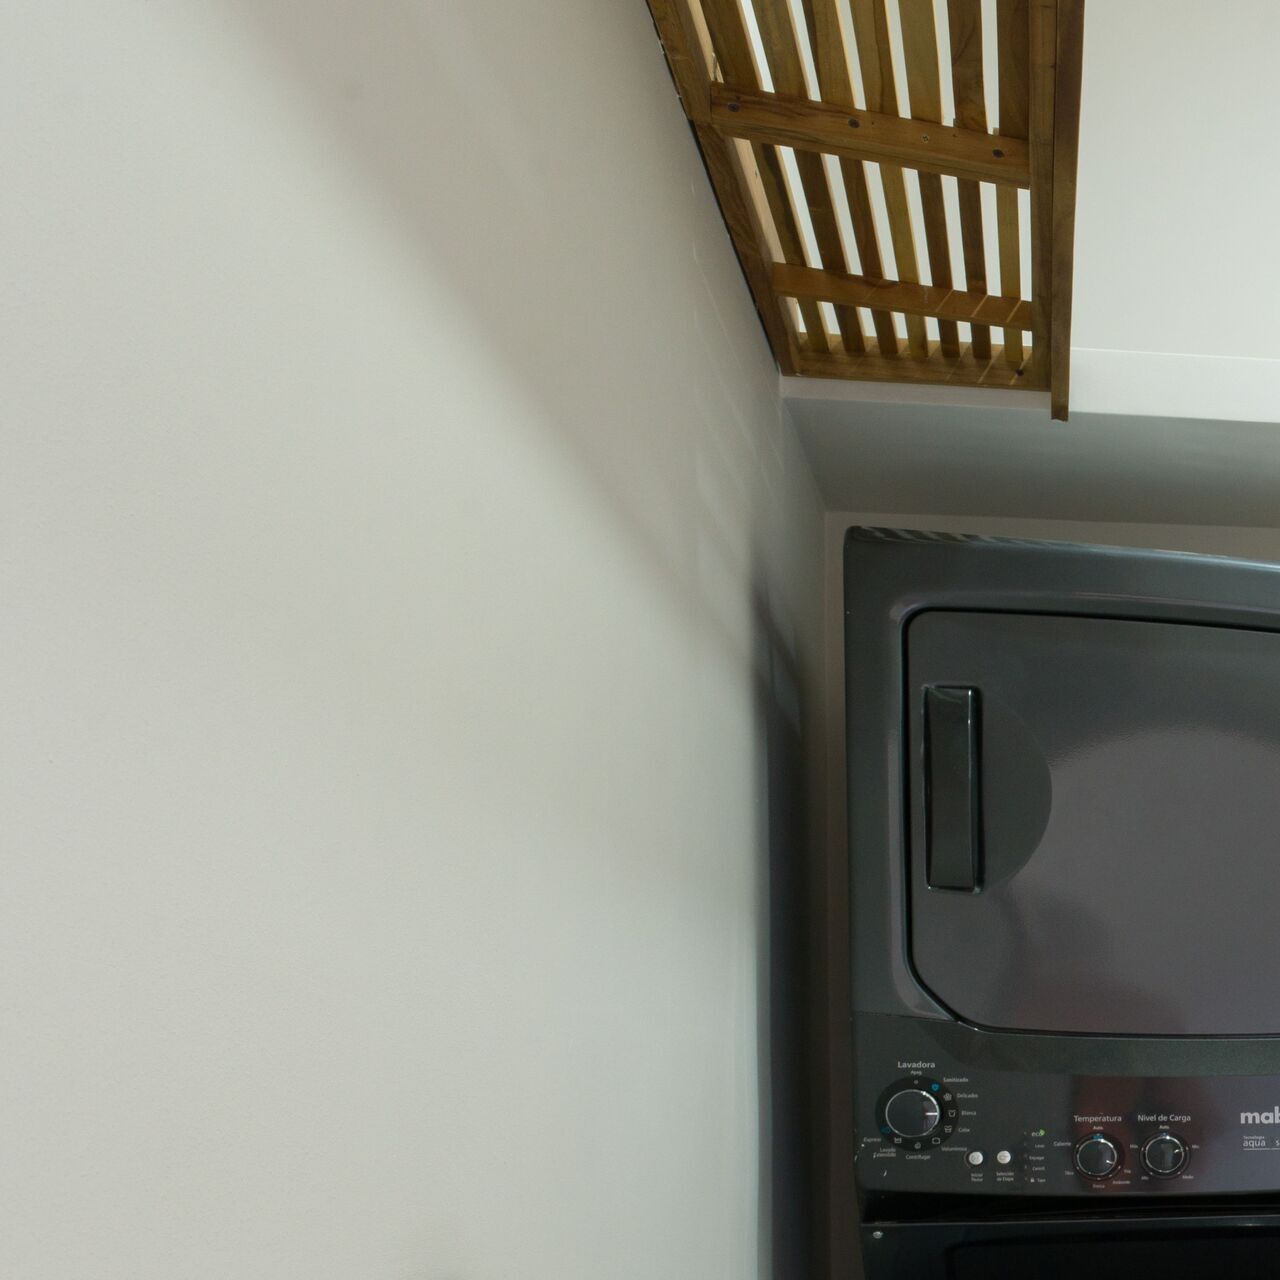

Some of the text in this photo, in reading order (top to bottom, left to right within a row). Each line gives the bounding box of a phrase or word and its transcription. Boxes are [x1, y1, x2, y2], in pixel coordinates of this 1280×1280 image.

[897, 1060, 936, 1069] Lavadora
[1074, 1115, 1122, 1123] Temperatura
[1169, 1115, 1191, 1123] Carga
